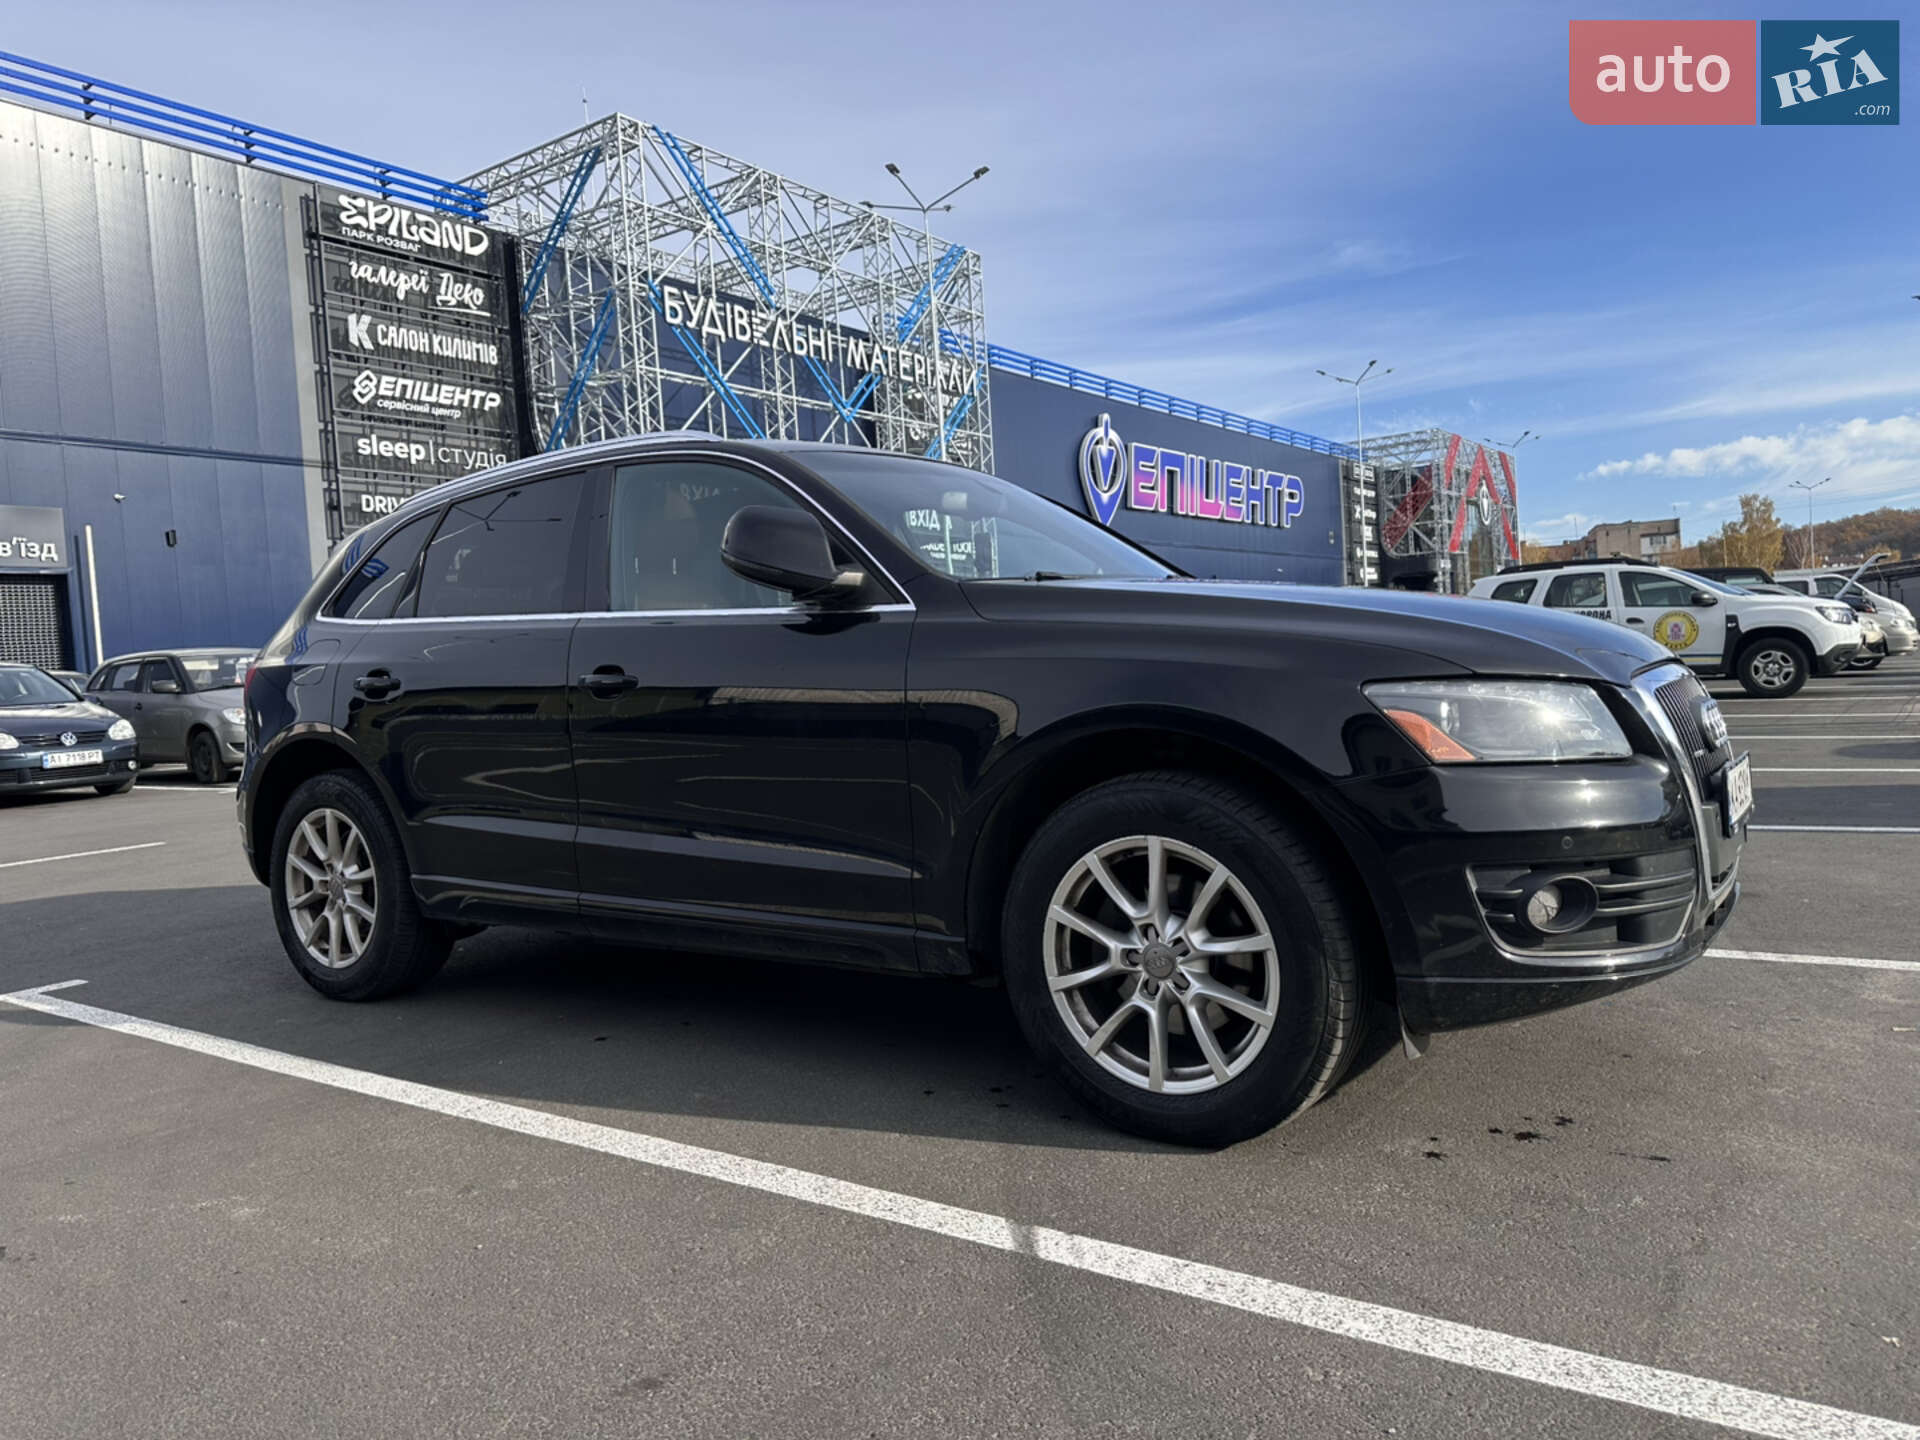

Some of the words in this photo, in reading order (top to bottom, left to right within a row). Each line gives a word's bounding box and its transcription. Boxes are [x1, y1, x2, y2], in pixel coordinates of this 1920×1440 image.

[341, 226, 374, 241] ПАРК
[377, 234, 421, 252] РОЗВАГ
[662, 285, 833, 362] БУДІВЕЛЬНІ
[377, 324, 430, 353] САЛОН
[432, 334, 498, 365] КИЛИМІВ
[377, 398, 430, 415] сервісний
[431, 406, 462, 419] центр
[378, 375, 501, 411] ЕПІЦЕНТР
[357, 434, 426, 464] sleep
[1127, 442, 1304, 528] ЕПІЦЕНТР
